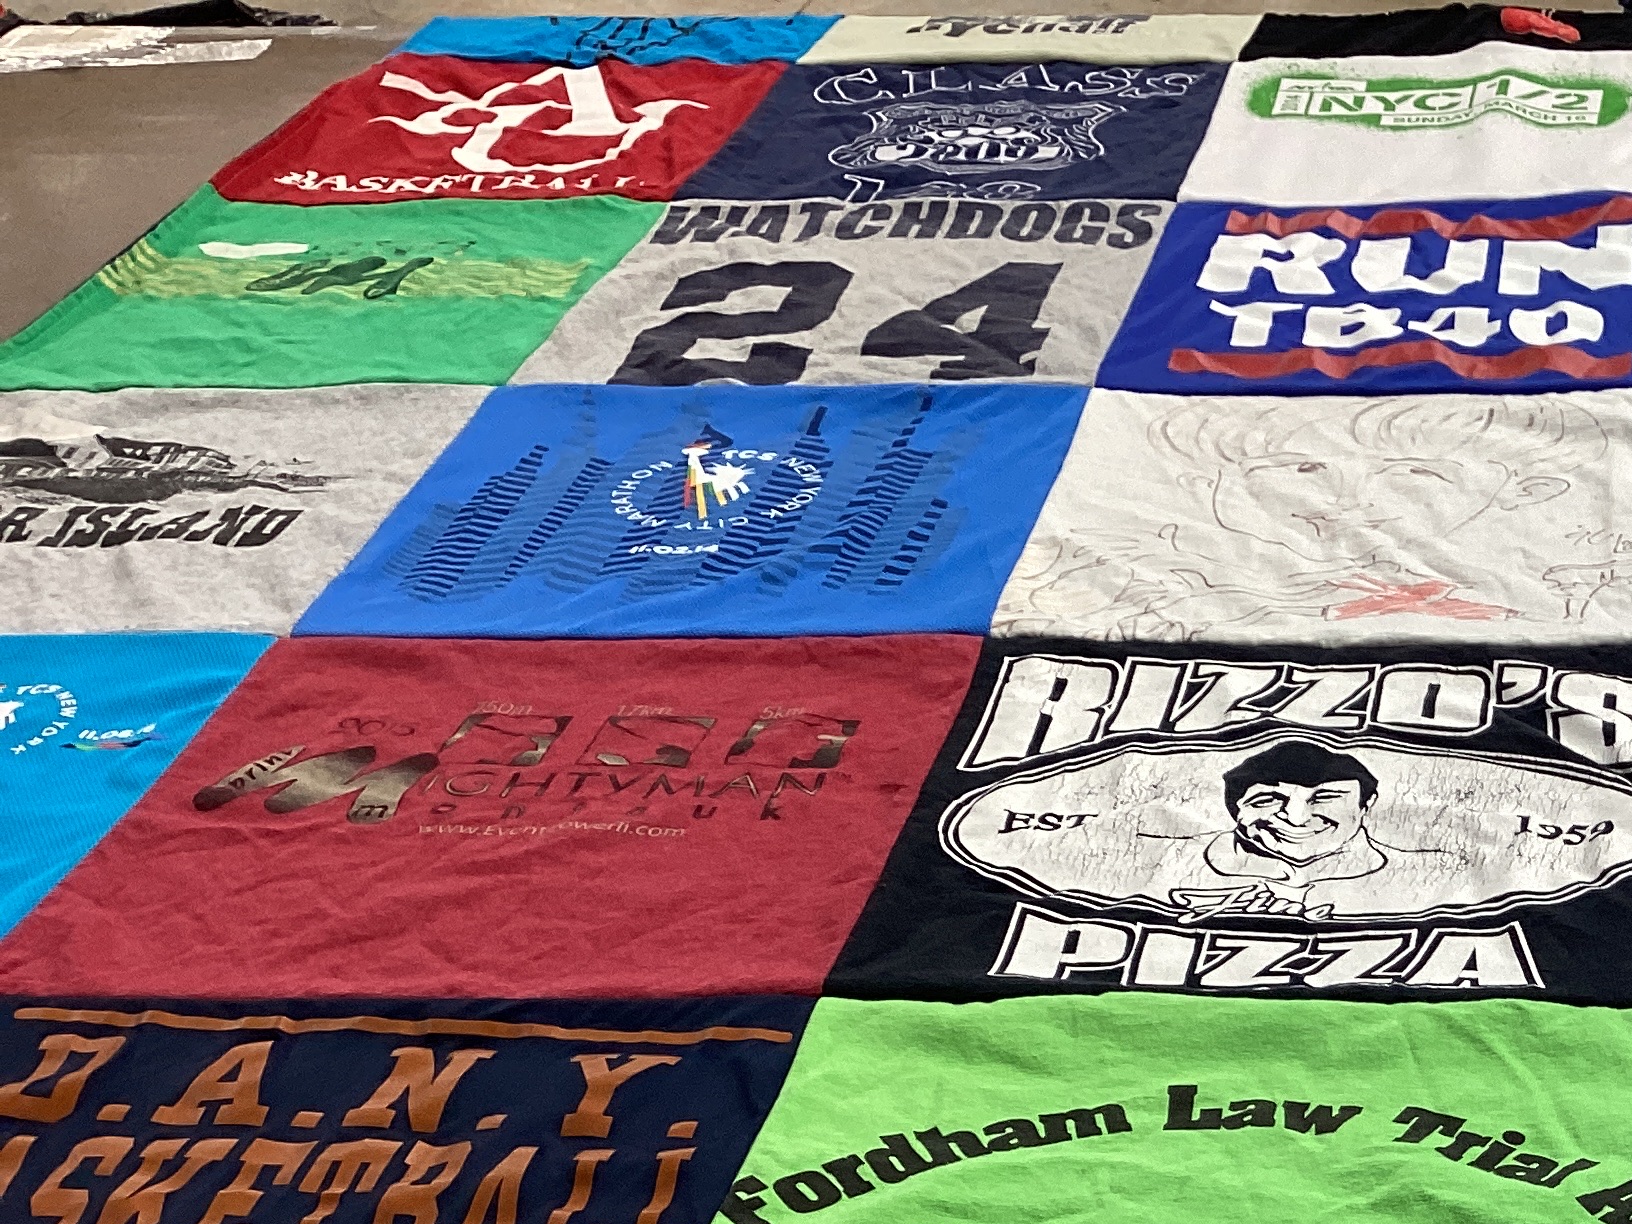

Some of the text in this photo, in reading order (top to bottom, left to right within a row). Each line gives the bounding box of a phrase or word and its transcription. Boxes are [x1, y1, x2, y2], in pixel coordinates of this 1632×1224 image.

[813, 64, 1206, 104] CLASS
[1319, 92, 1463, 112] NYC
[1486, 78, 1590, 110] 1/2
[1393, 112, 1473, 123] SUNDAY
[1484, 100, 1557, 121] MARCH
[648, 201, 1161, 249] WATCHDOGS
[606, 260, 1063, 385] 24
[1209, 300, 1605, 348] TB40
[610, 450, 824, 531] TCS NEW YORK CITY MARATHON
[36, 505, 304, 547] ISLAND
[997, 811, 1098, 834] EST
[1514, 814, 1615, 846] 1959
[1170, 883, 1334, 924] Fine
[989, 902, 1546, 989] PIZZA
[1163, 1084, 1364, 1135] Law
[1391, 1105, 1600, 1188] Trial
